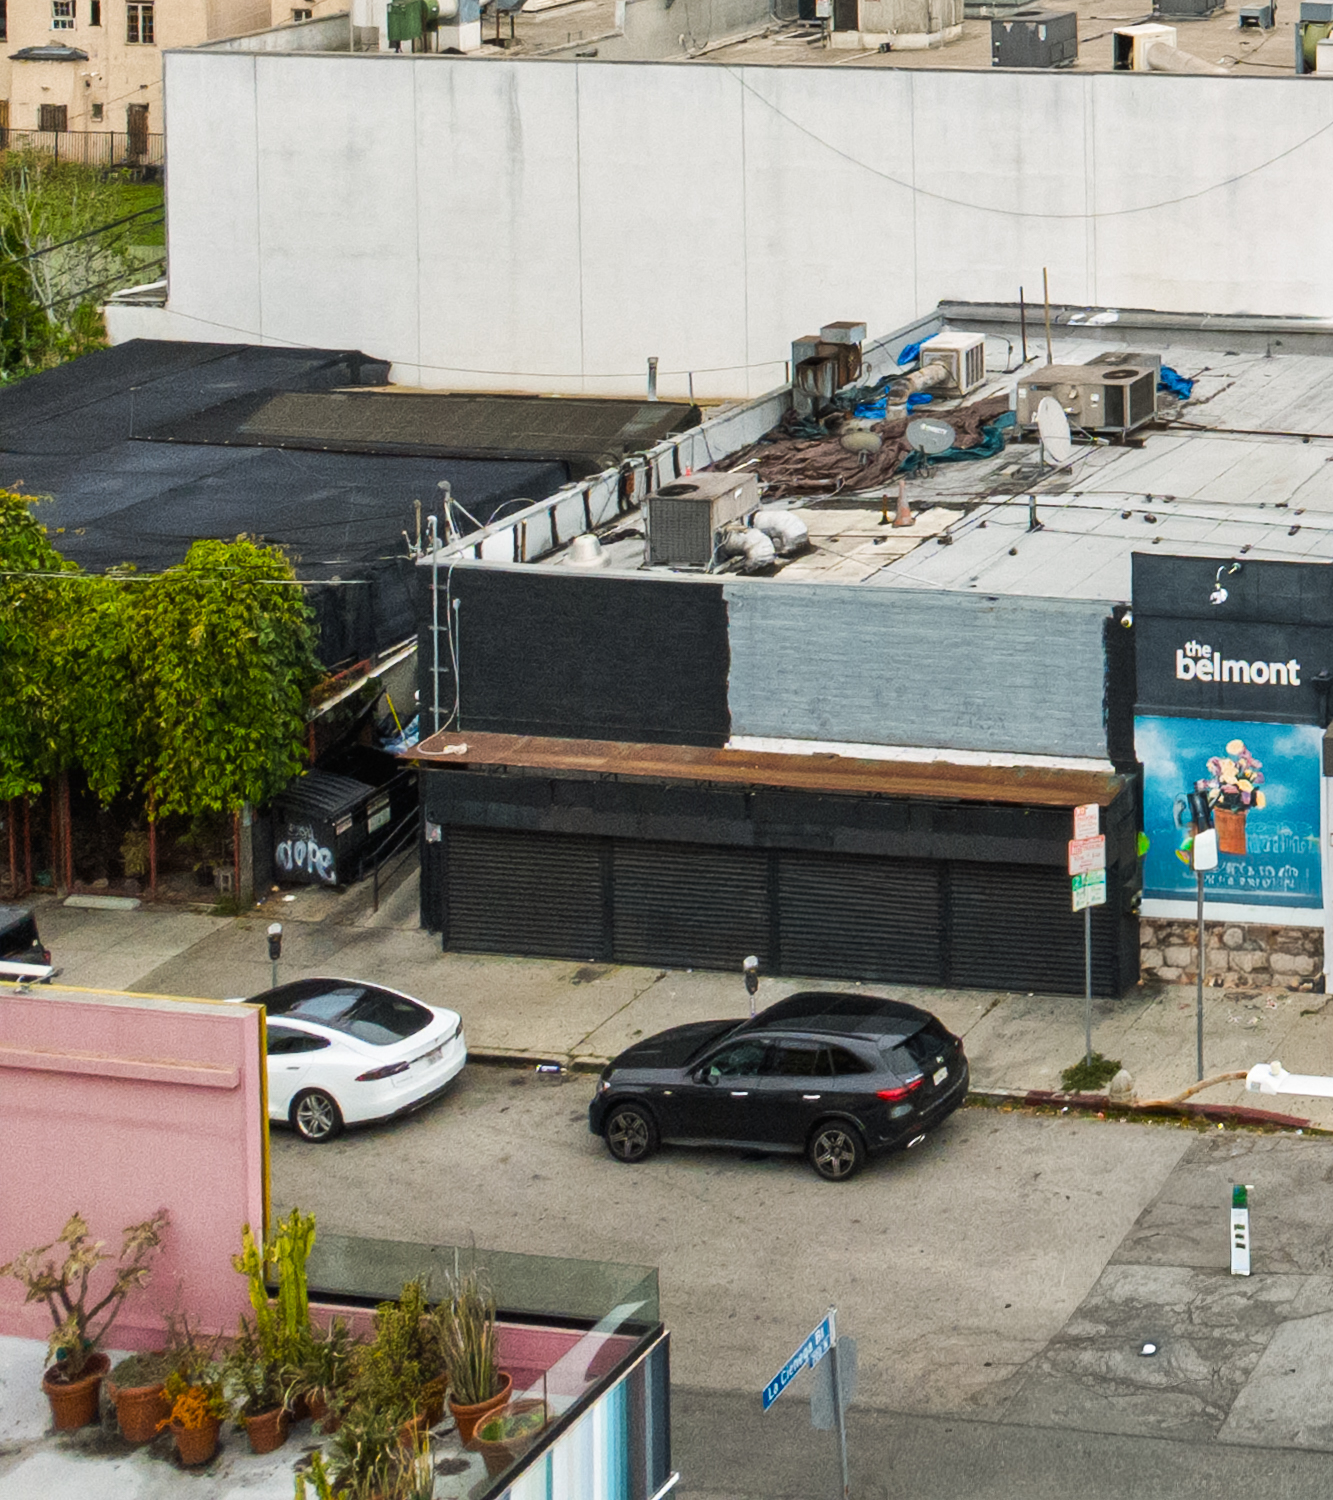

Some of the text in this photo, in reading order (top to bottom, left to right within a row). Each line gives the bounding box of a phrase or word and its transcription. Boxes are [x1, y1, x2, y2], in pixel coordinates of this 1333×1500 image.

[1184, 639, 1212, 658] the
[1176, 649, 1301, 686] belmont
[767, 1382, 779, 1401] La
[780, 1341, 813, 1386] Cienega
